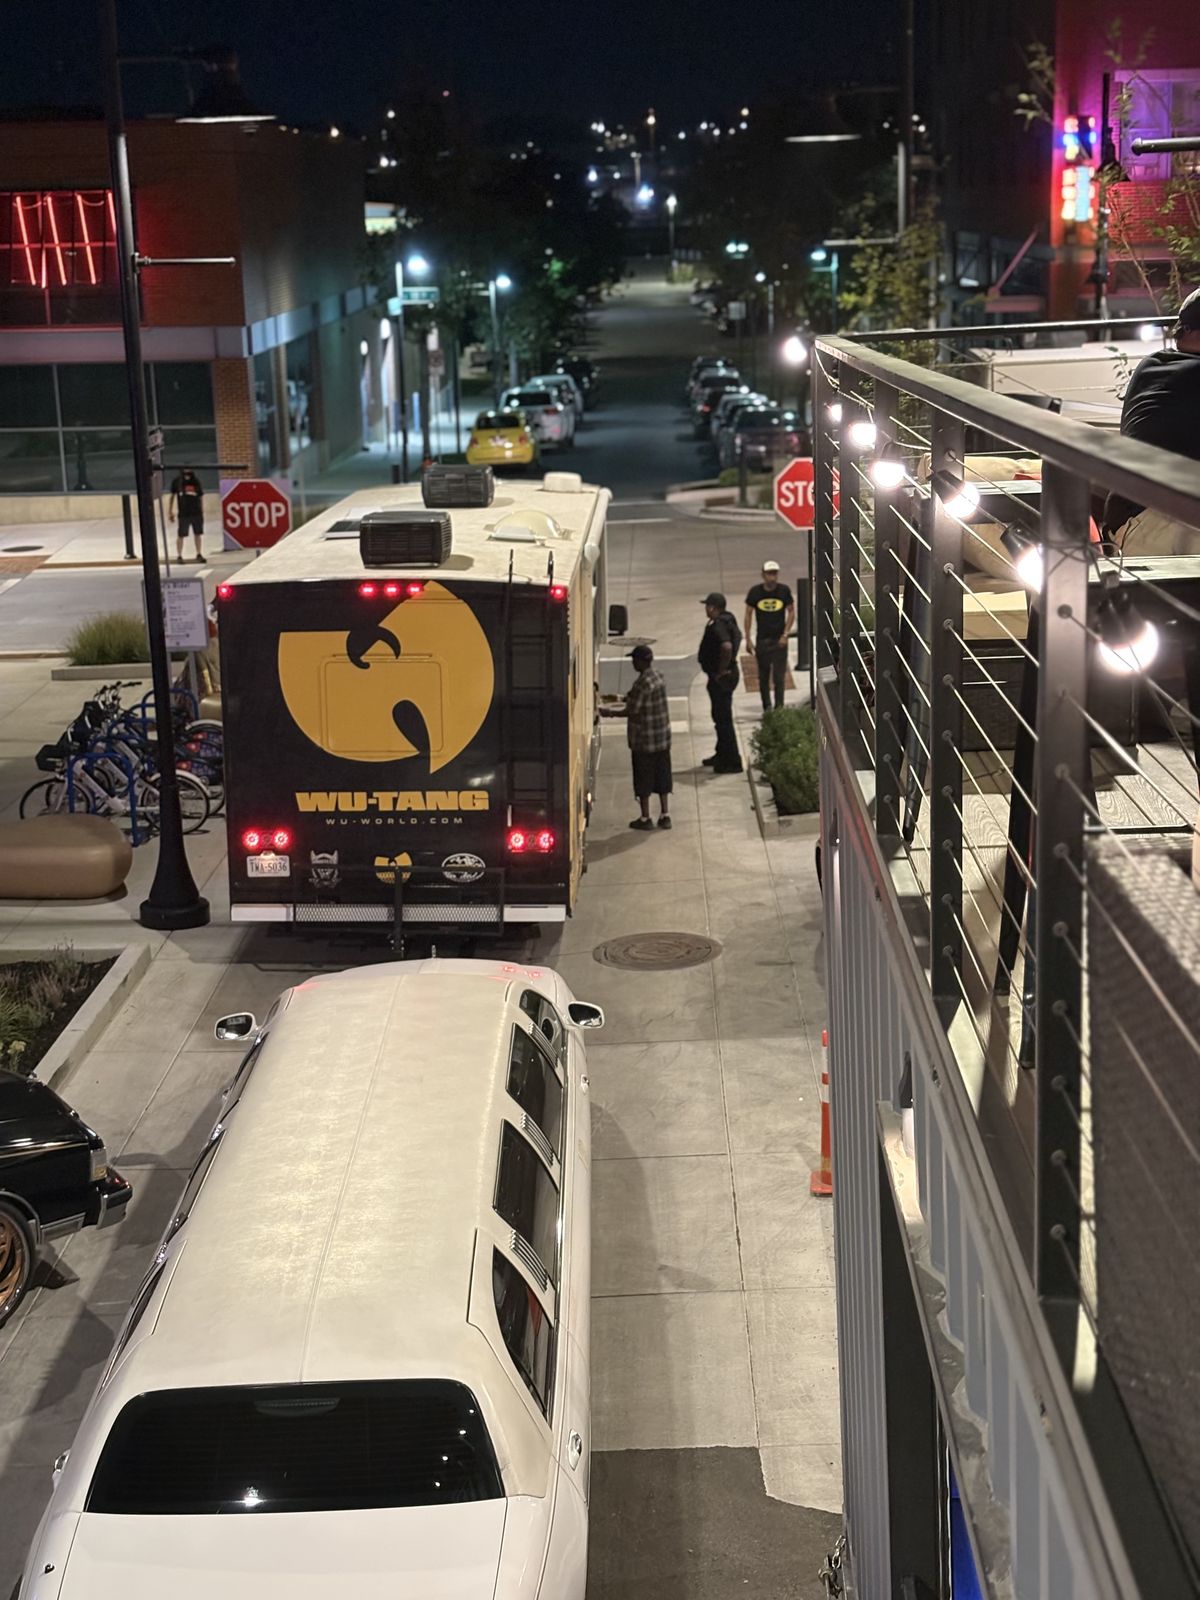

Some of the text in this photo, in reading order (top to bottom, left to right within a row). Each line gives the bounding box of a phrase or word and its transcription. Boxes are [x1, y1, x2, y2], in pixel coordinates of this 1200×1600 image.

[226, 502, 286, 528] STOP
[295, 790, 490, 812] WU-TANG
[325, 817, 464, 825] WU-WORLD.COM
